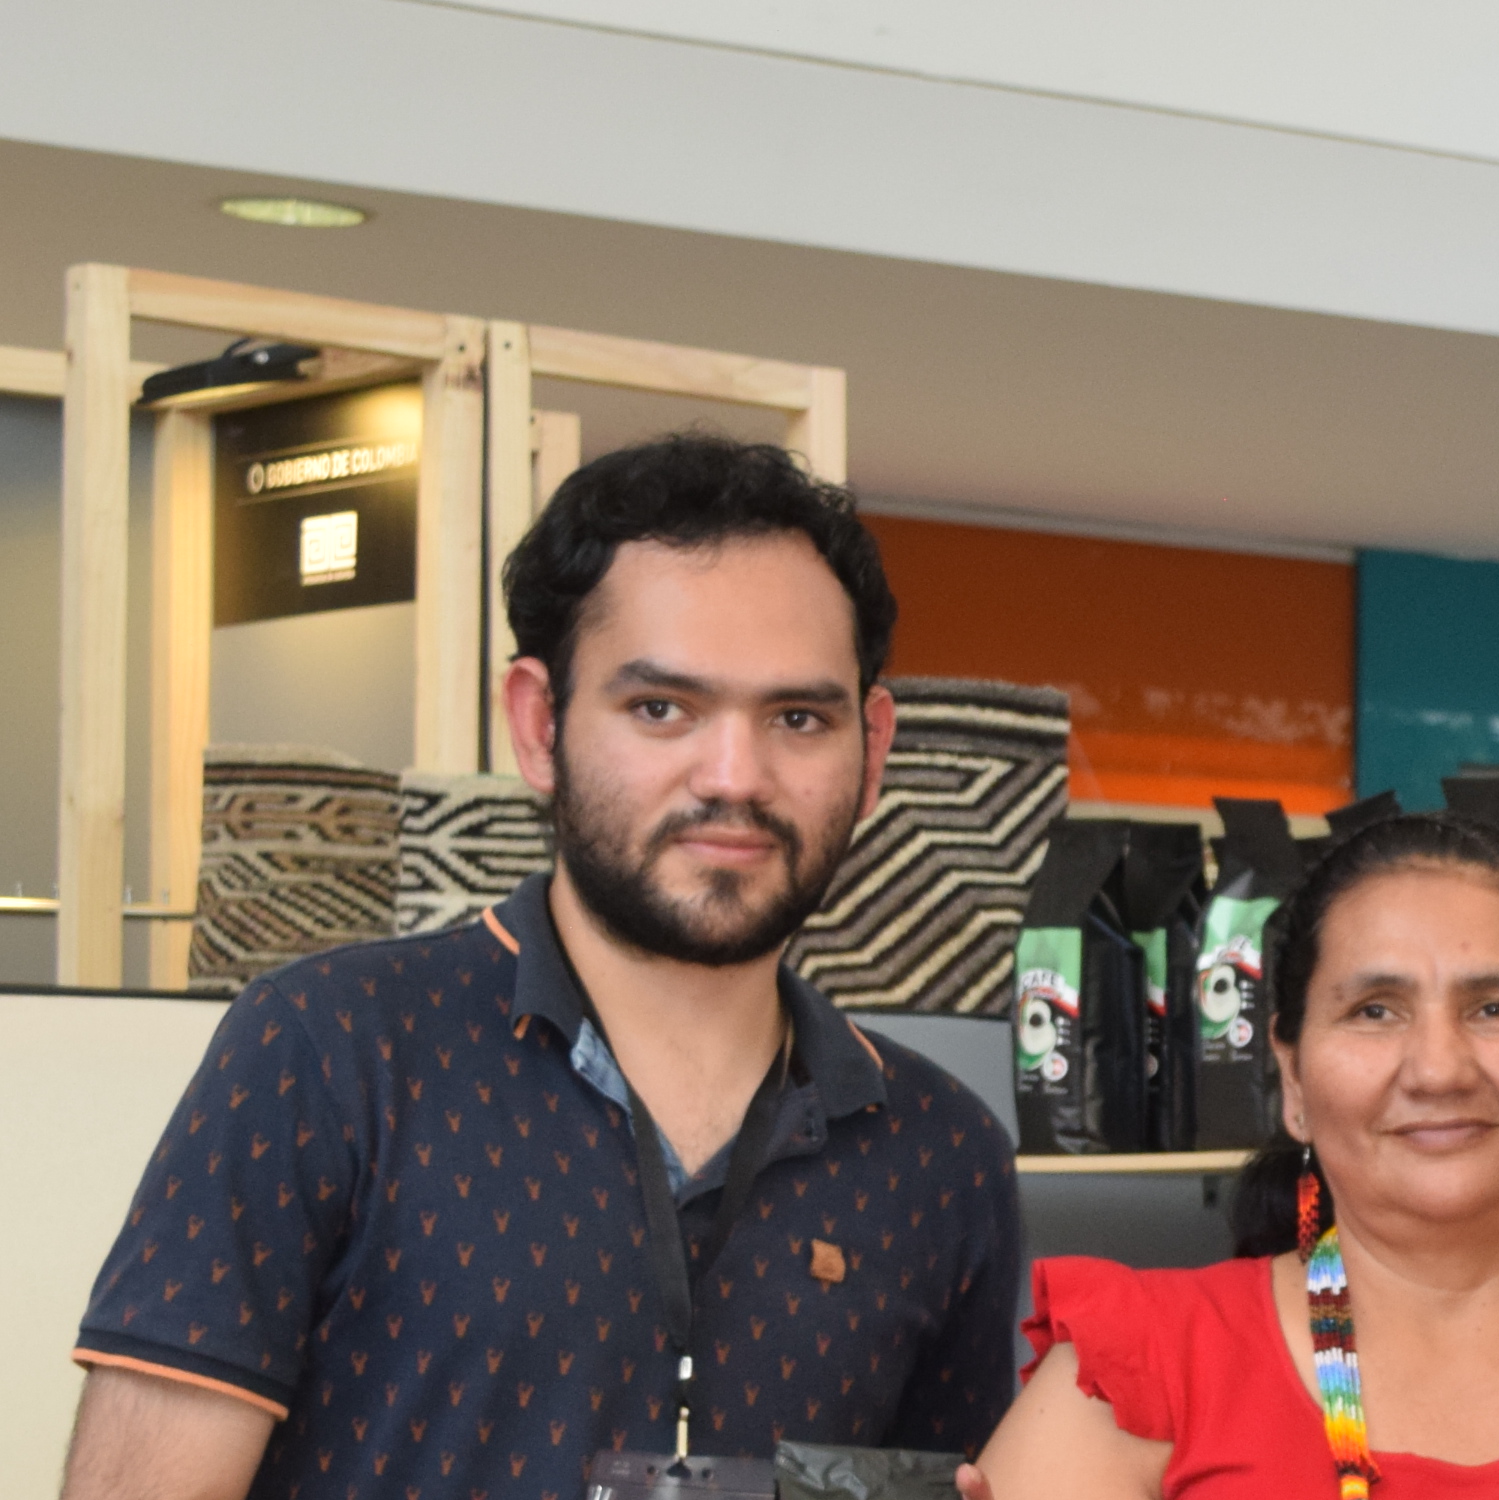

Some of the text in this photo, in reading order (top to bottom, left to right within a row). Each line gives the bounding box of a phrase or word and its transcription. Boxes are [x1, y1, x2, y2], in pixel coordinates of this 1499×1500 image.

[265, 443, 417, 490] GOBIERNO DE COLOMBIA
